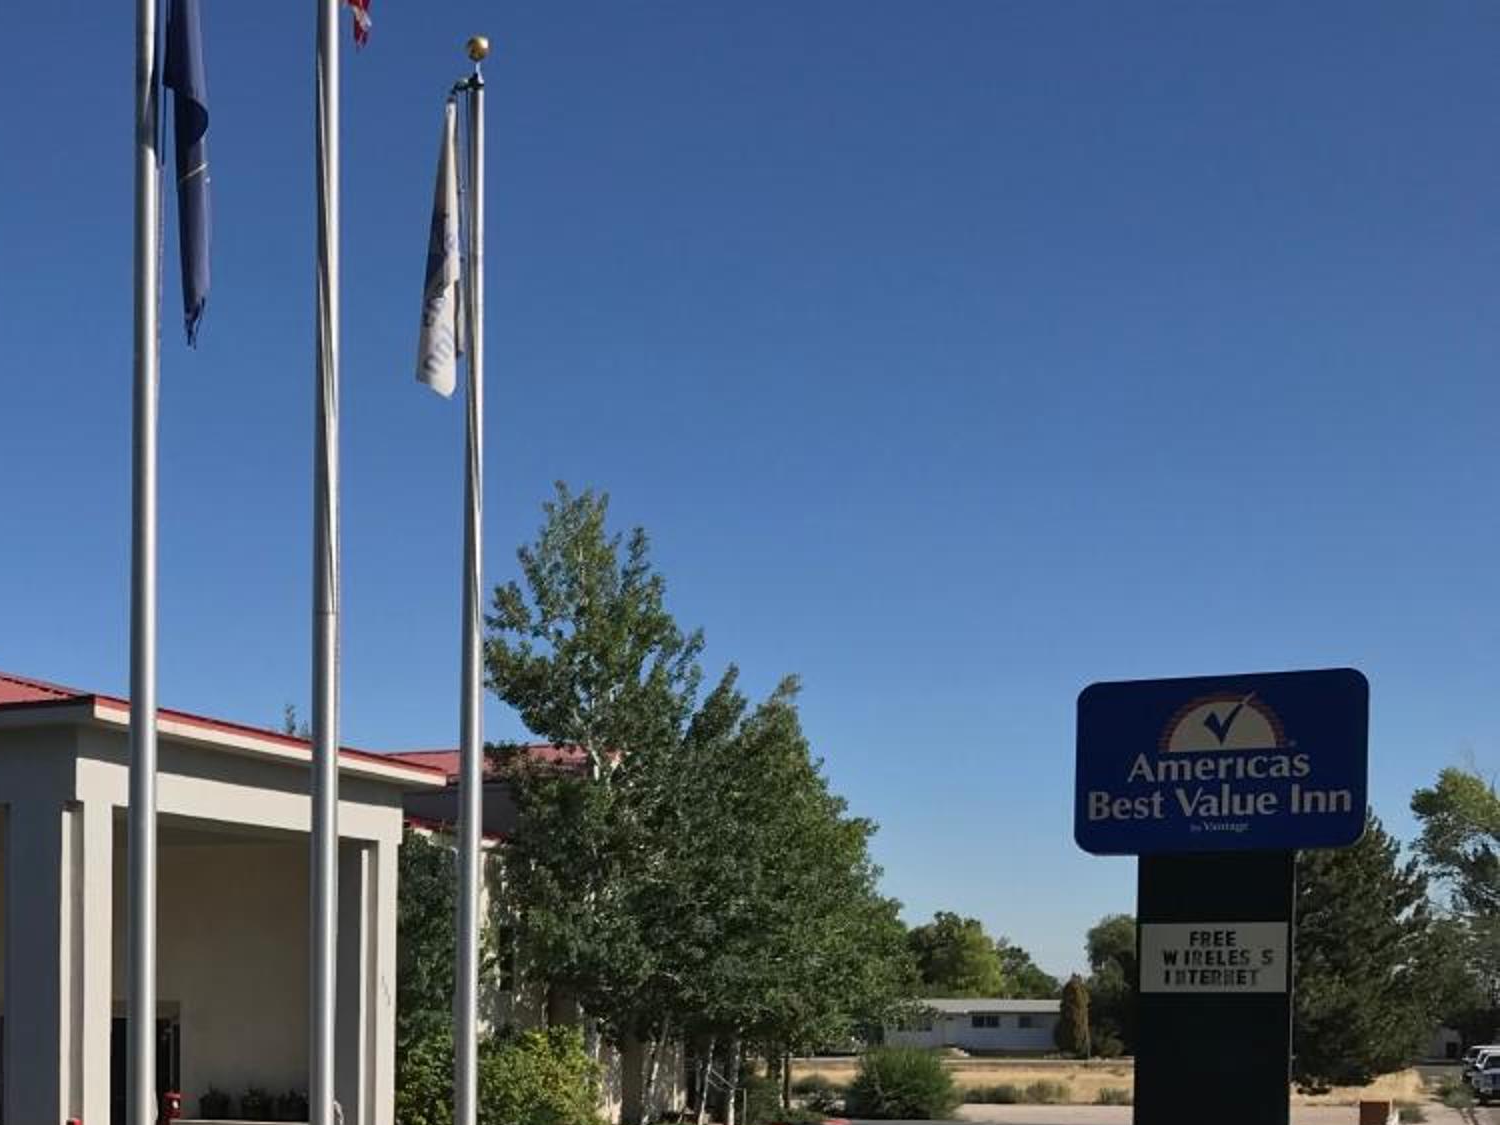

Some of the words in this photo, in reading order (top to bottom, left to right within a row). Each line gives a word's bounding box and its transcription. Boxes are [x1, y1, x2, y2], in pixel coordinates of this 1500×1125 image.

[1127, 752, 1311, 783] Americas
[1087, 789, 1165, 821] Best
[1175, 783, 1277, 817] Value
[1290, 783, 1351, 815] Inn
[1189, 930, 1237, 947] FREE
[1164, 969, 1259, 985] INTERNET
